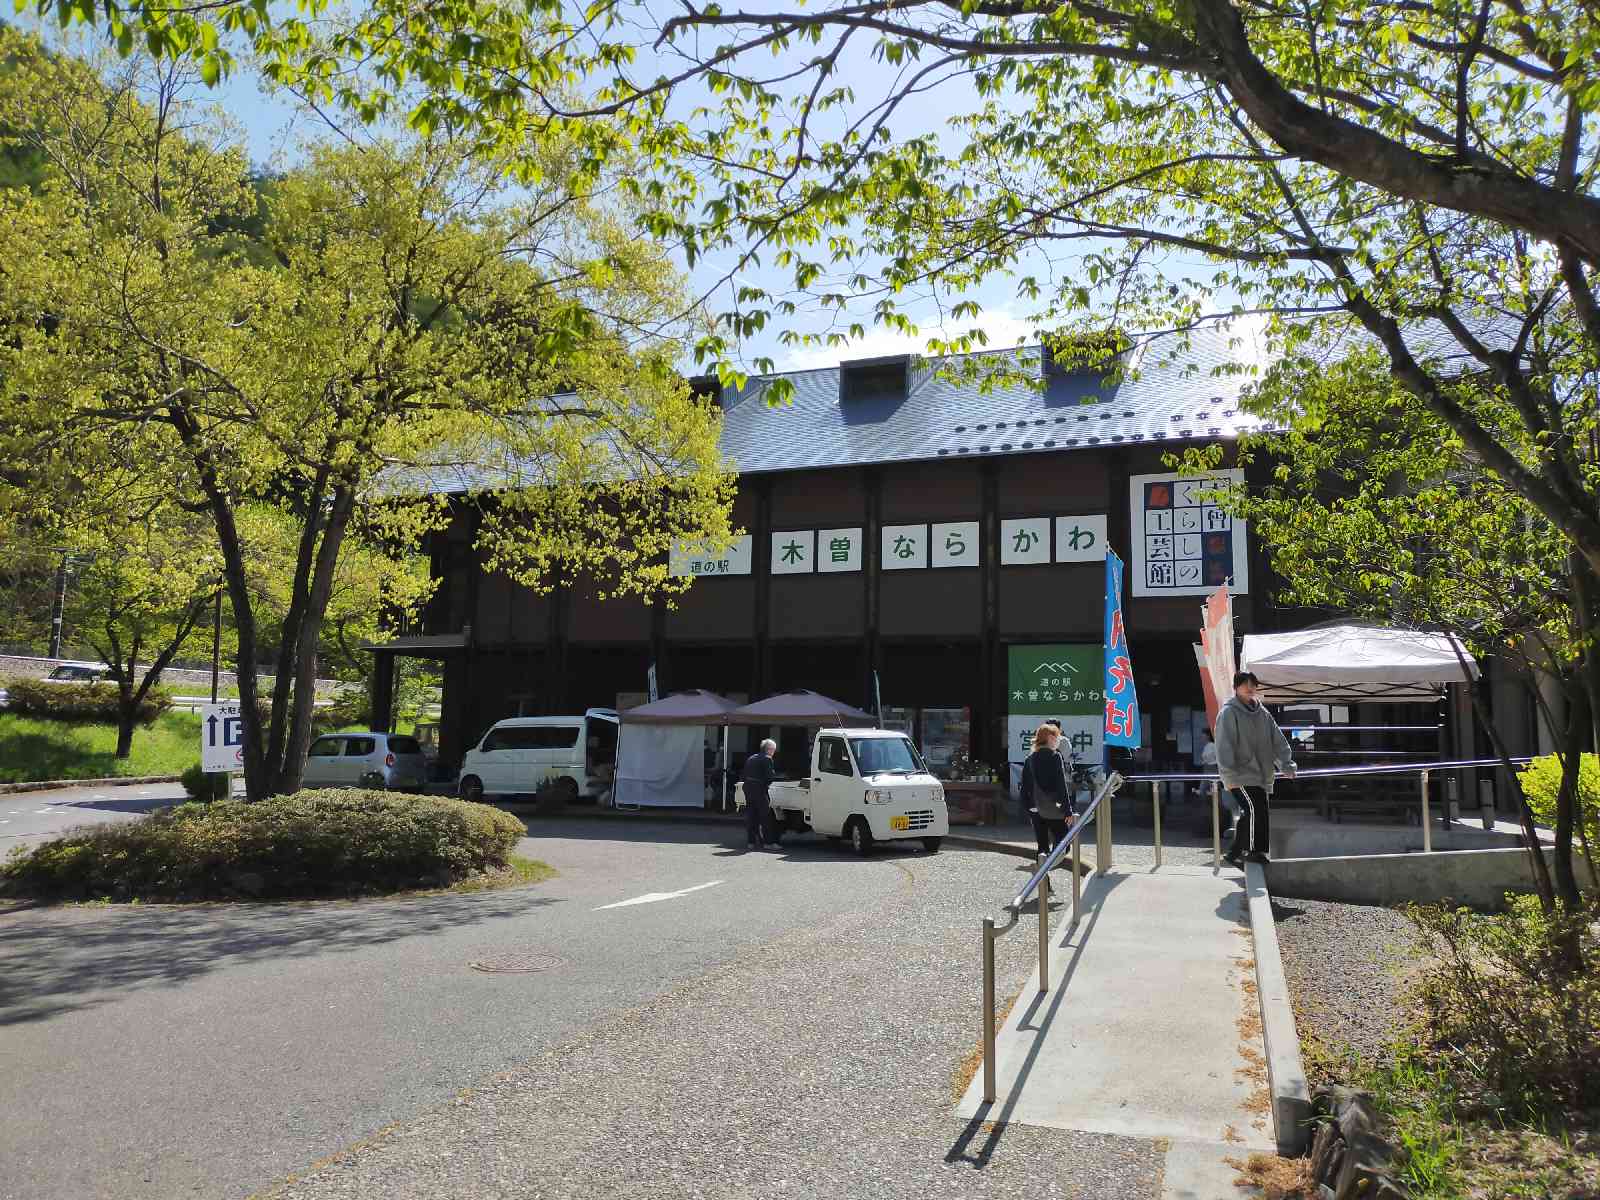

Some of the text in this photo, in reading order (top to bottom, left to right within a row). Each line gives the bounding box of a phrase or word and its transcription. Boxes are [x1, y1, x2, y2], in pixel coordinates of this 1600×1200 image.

[1179, 484, 1200, 581] くらしの
[1149, 511, 1173, 585] 工芸館
[690, 559, 730, 574] 道の駅
[1040, 677, 1072, 687] 道の駅
[218, 706, 241, 715] 大駐
[1019, 729, 1093, 753] 営中
